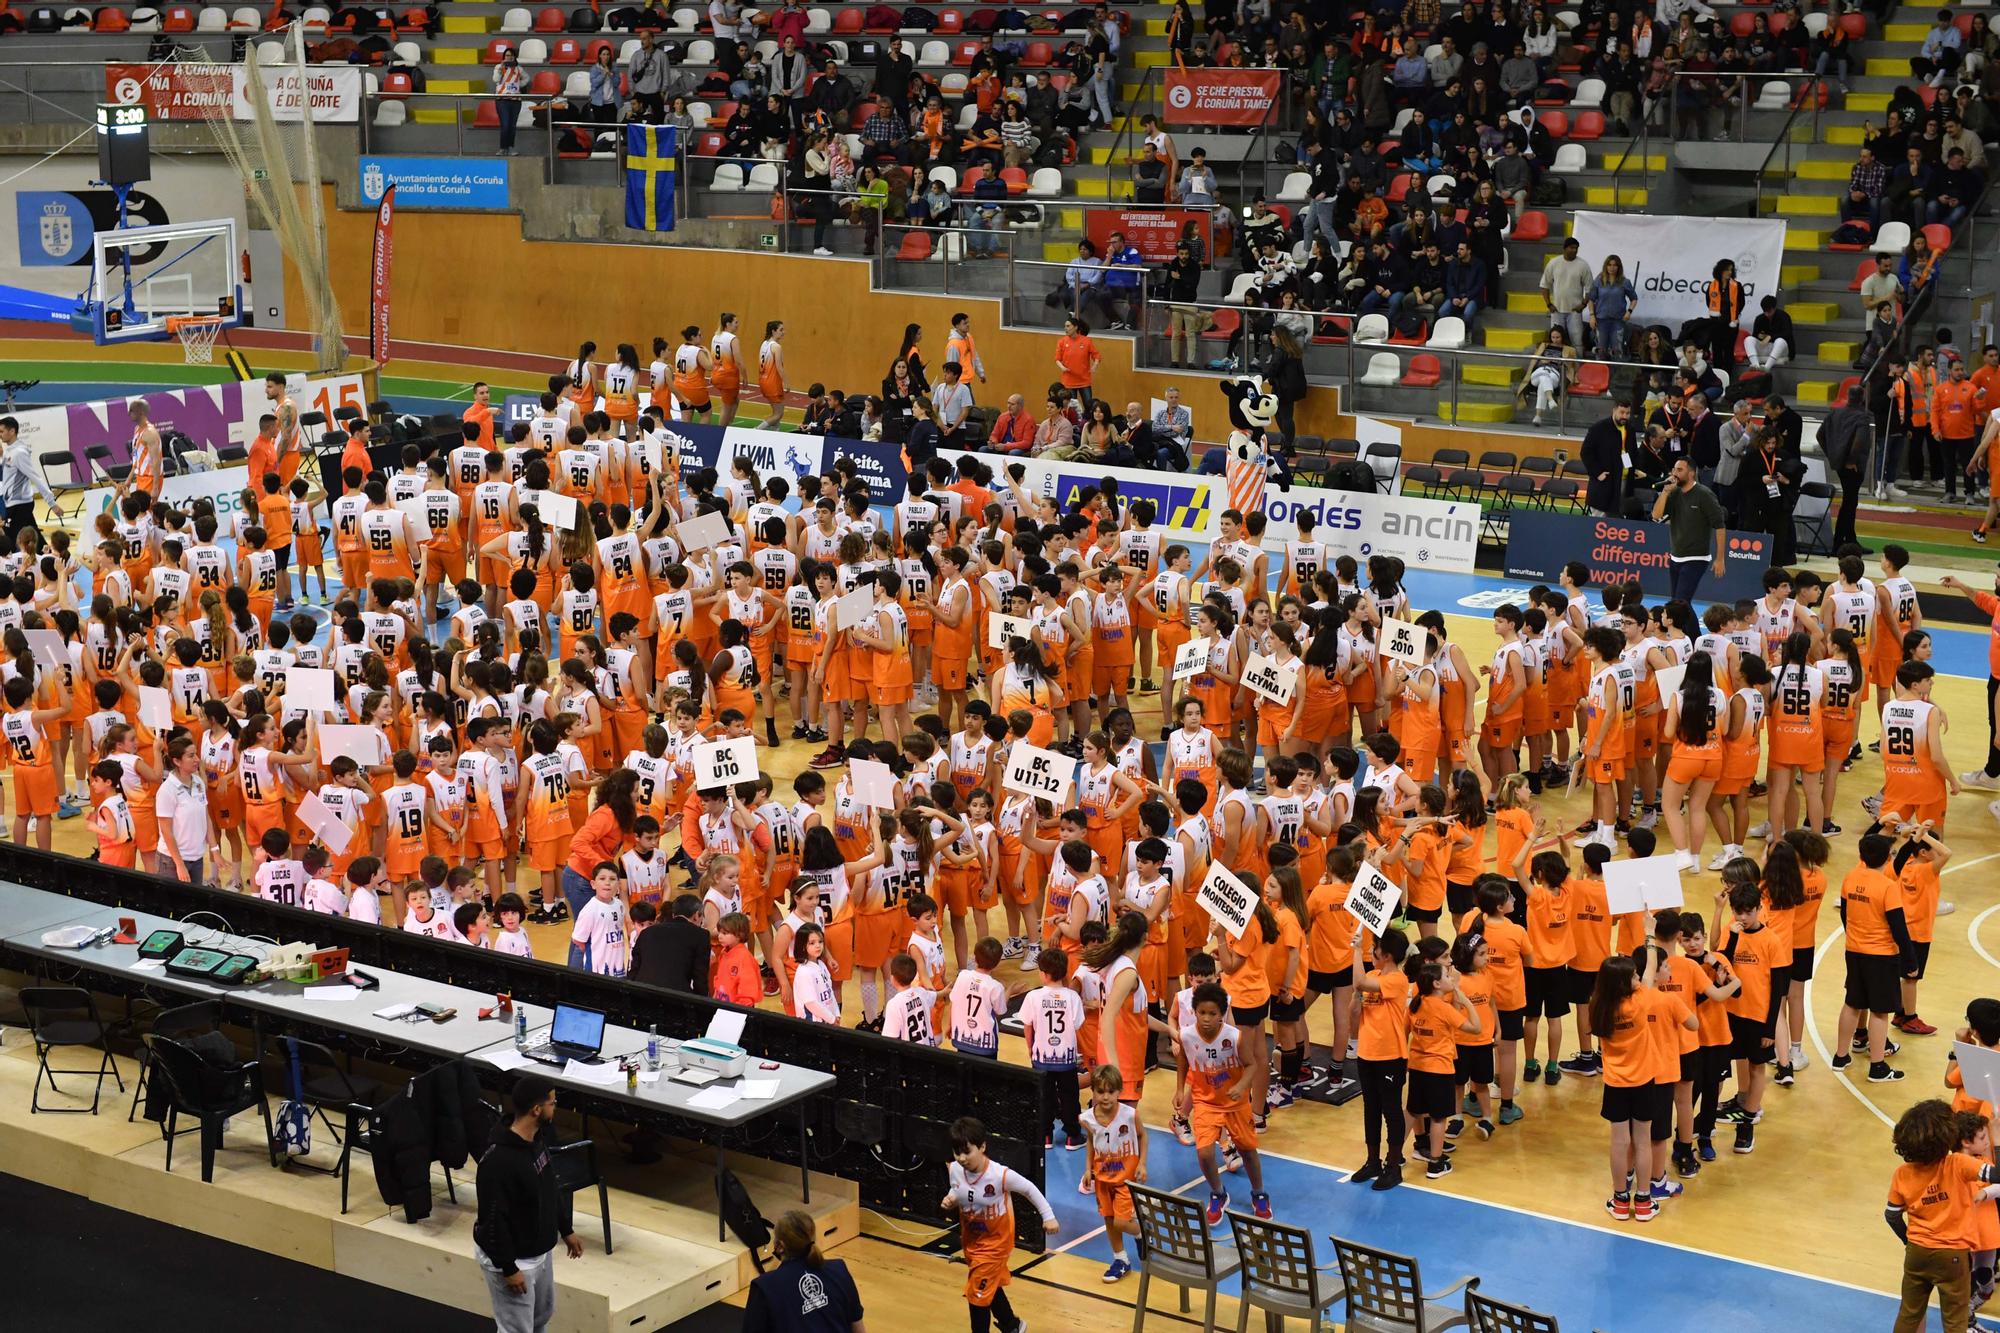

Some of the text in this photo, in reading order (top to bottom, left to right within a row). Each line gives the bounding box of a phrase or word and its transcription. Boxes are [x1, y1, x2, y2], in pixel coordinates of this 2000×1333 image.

[1196, 85, 1208, 96] SE
[1209, 86, 1226, 96] CHE
[1204, 97, 1240, 109] CORUÑA
[115, 109, 144, 124] 3:00
[387, 173, 504, 185] Ayuntamiento de A Coruña
[394, 183, 471, 194] oncello da Coruña
[612, 378, 627, 393] 17
[543, 434, 553, 453] 3
[460, 464, 480, 484] 88
[571, 467, 589, 487] 36
[428, 508, 449, 529] 66
[483, 499, 499, 520] 16
[340, 515, 356, 536] 47
[1381, 505, 1472, 543] ancín
[1594, 521, 1646, 543] See a
[370, 529, 392, 551] 52
[1129, 549, 1150, 571] 99
[1591, 545, 1670, 570] different
[1728, 550, 1761, 561] Securitas
[199, 565, 220, 588] 34
[613, 554, 633, 580] 24
[1508, 566, 1544, 578] securitas.es
[1590, 567, 1641, 587] world
[259, 569, 276, 591] 36
[765, 567, 786, 590] 59
[572, 608, 592, 632] 80
[672, 611, 683, 634] 7
[791, 607, 812, 630] 22
[1004, 622, 1015, 633] BC
[1850, 614, 1866, 638] 31
[1397, 628, 1410, 641] BC
[1188, 648, 1196, 658] BC
[1390, 639, 1414, 656] 2010
[1174, 659, 1194, 673] LEYMA
[1263, 667, 1277, 681] BC
[1246, 671, 1287, 699] LEYMA I
[1783, 689, 1810, 716] 52
[1887, 726, 1914, 756] 29
[715, 748, 733, 763] BC
[1031, 756, 1051, 773] BC
[713, 762, 740, 779] U10
[1014, 768, 1060, 793] U11-12
[243, 772, 262, 800] 21
[639, 777, 655, 806] 3
[399, 808, 422, 839] 19
[271, 869, 291, 880] LUCAS
[1369, 873, 1388, 893] CEIP
[269, 883, 296, 907] 30
[1212, 874, 1248, 911] COLEGIO
[1359, 886, 1386, 913] CURROS
[1201, 886, 1246, 928] MONTESPIÑO
[966, 993, 983, 1018] 17
[906, 1010, 928, 1042] 23
[1044, 1009, 1066, 1034] 13
[1205, 1048, 1218, 1059] 72
[1104, 1132, 1111, 1144] 7
